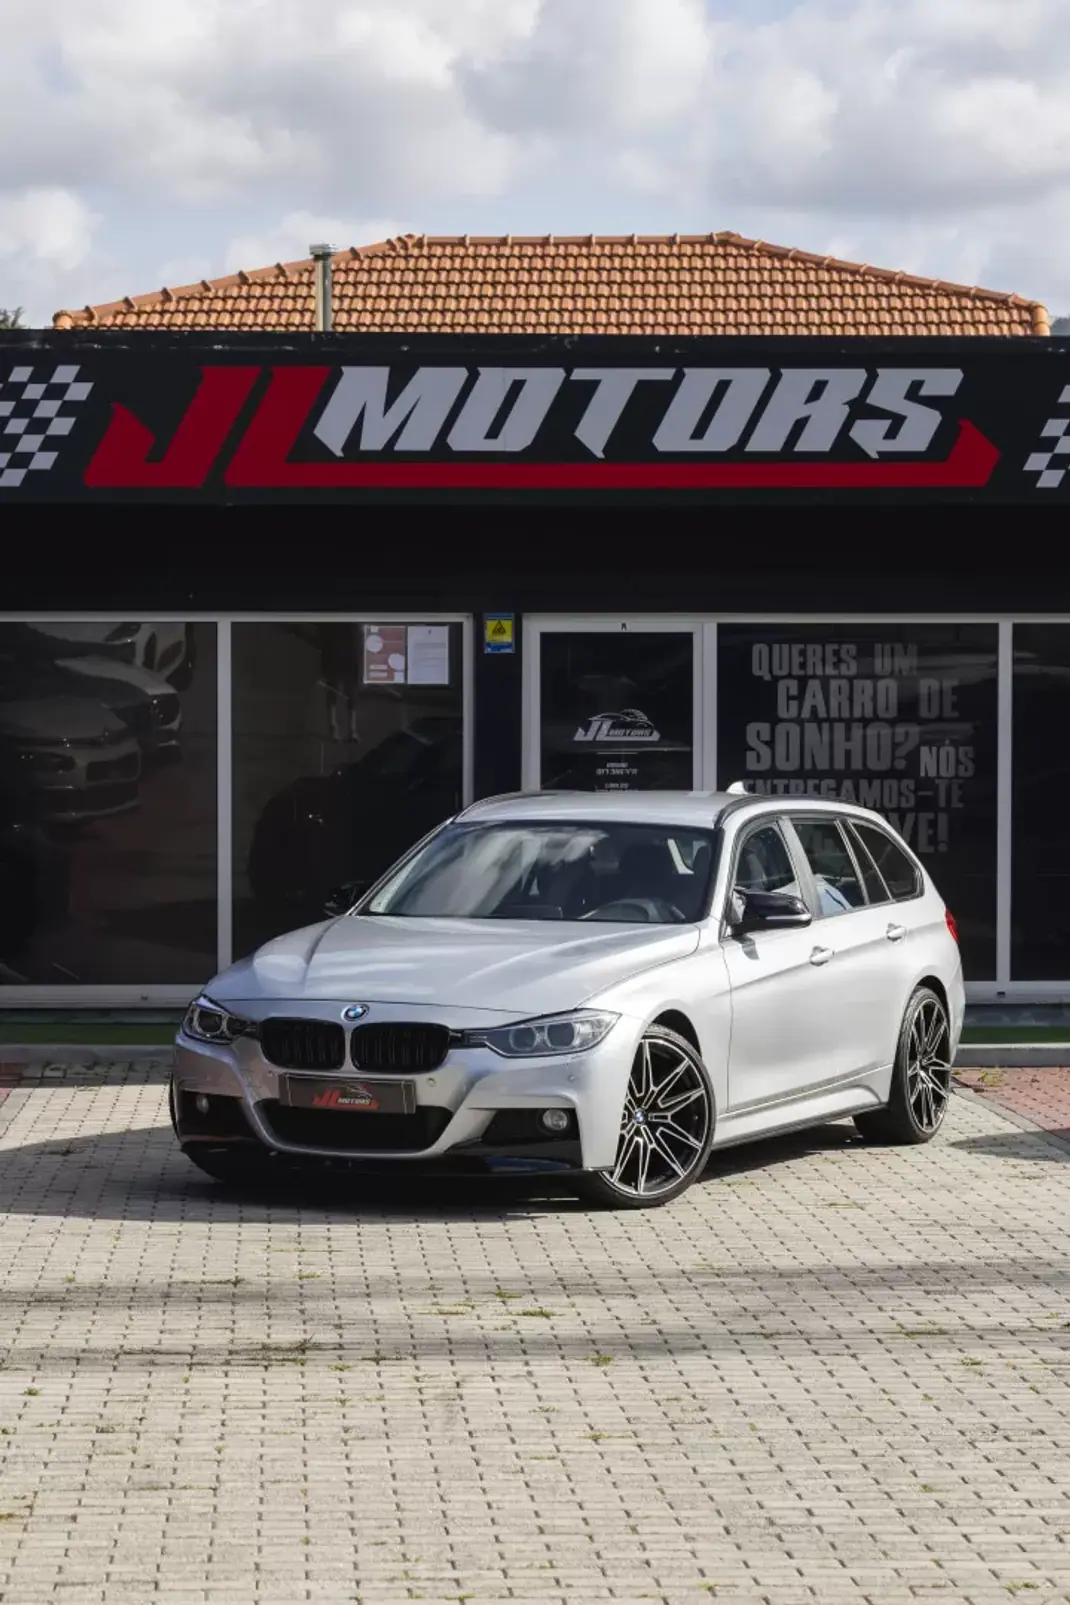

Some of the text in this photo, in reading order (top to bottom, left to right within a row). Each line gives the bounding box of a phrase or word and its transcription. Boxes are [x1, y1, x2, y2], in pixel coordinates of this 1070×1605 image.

[752, 643, 919, 681] QUERES UM
[777, 678, 960, 719] CARRO DE
[746, 722, 976, 778] SONHO? NÓS
